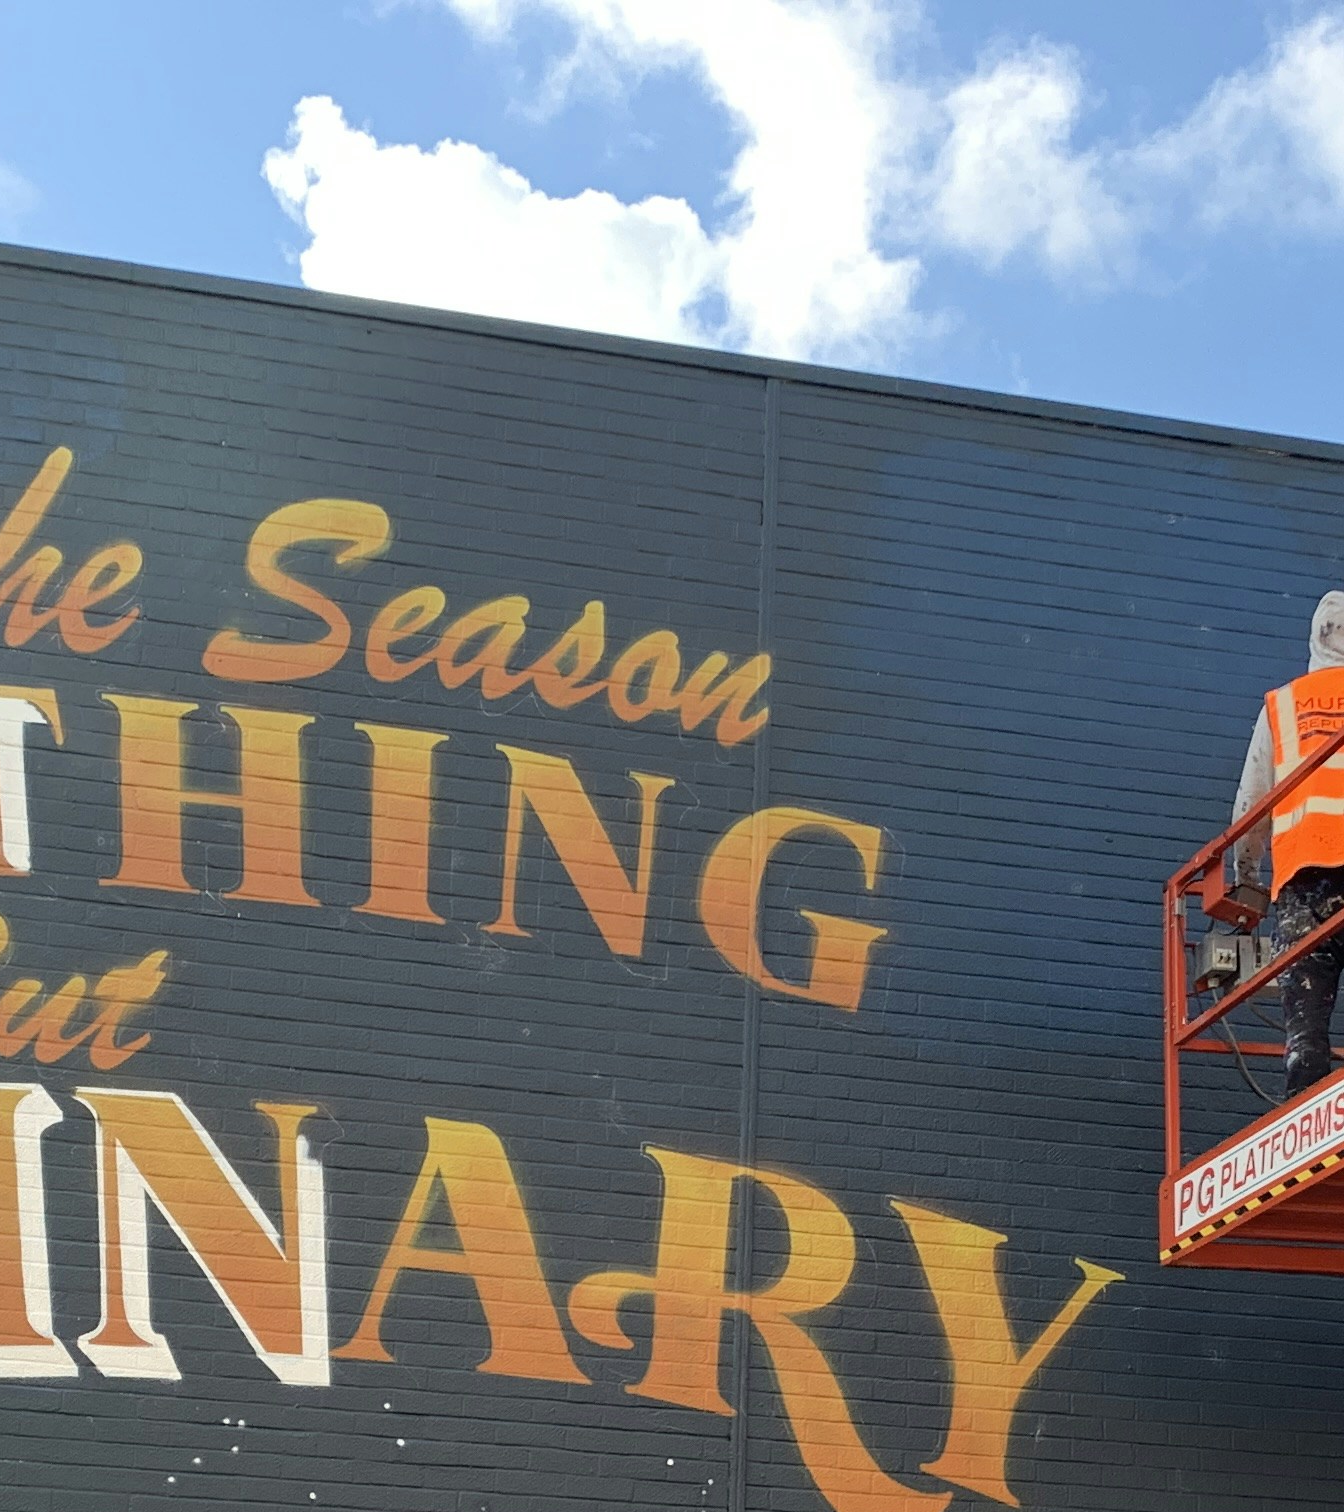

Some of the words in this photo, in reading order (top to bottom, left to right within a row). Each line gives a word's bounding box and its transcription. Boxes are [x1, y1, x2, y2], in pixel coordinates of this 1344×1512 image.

[203, 499, 773, 746] Season
[1298, 717, 1344, 732] REPU
[1178, 1165, 1216, 1228] PG
